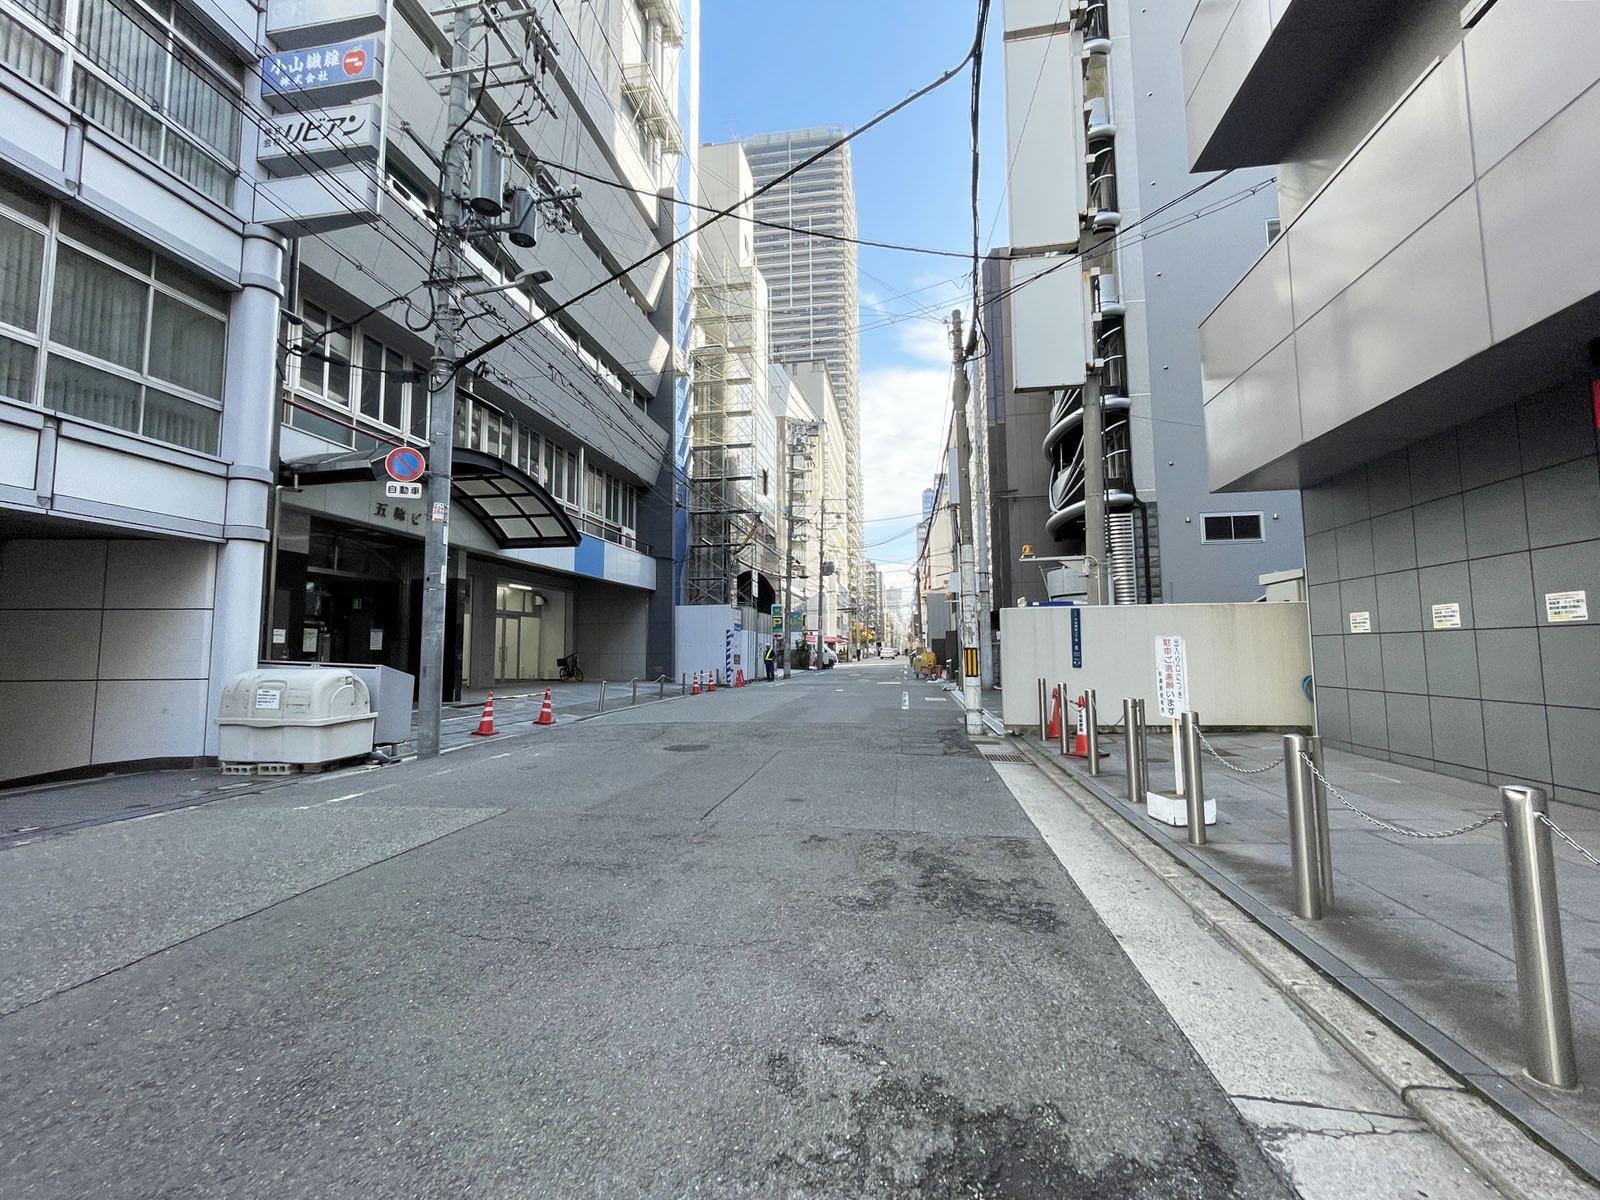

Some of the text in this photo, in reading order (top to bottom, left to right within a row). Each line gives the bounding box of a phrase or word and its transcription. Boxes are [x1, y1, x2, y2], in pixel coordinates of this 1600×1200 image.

[280, 70, 329, 87] 株式会社
[285, 115, 366, 143] リビアン
[388, 485, 420, 495] 自動車
[772, 618, 782, 628] P
